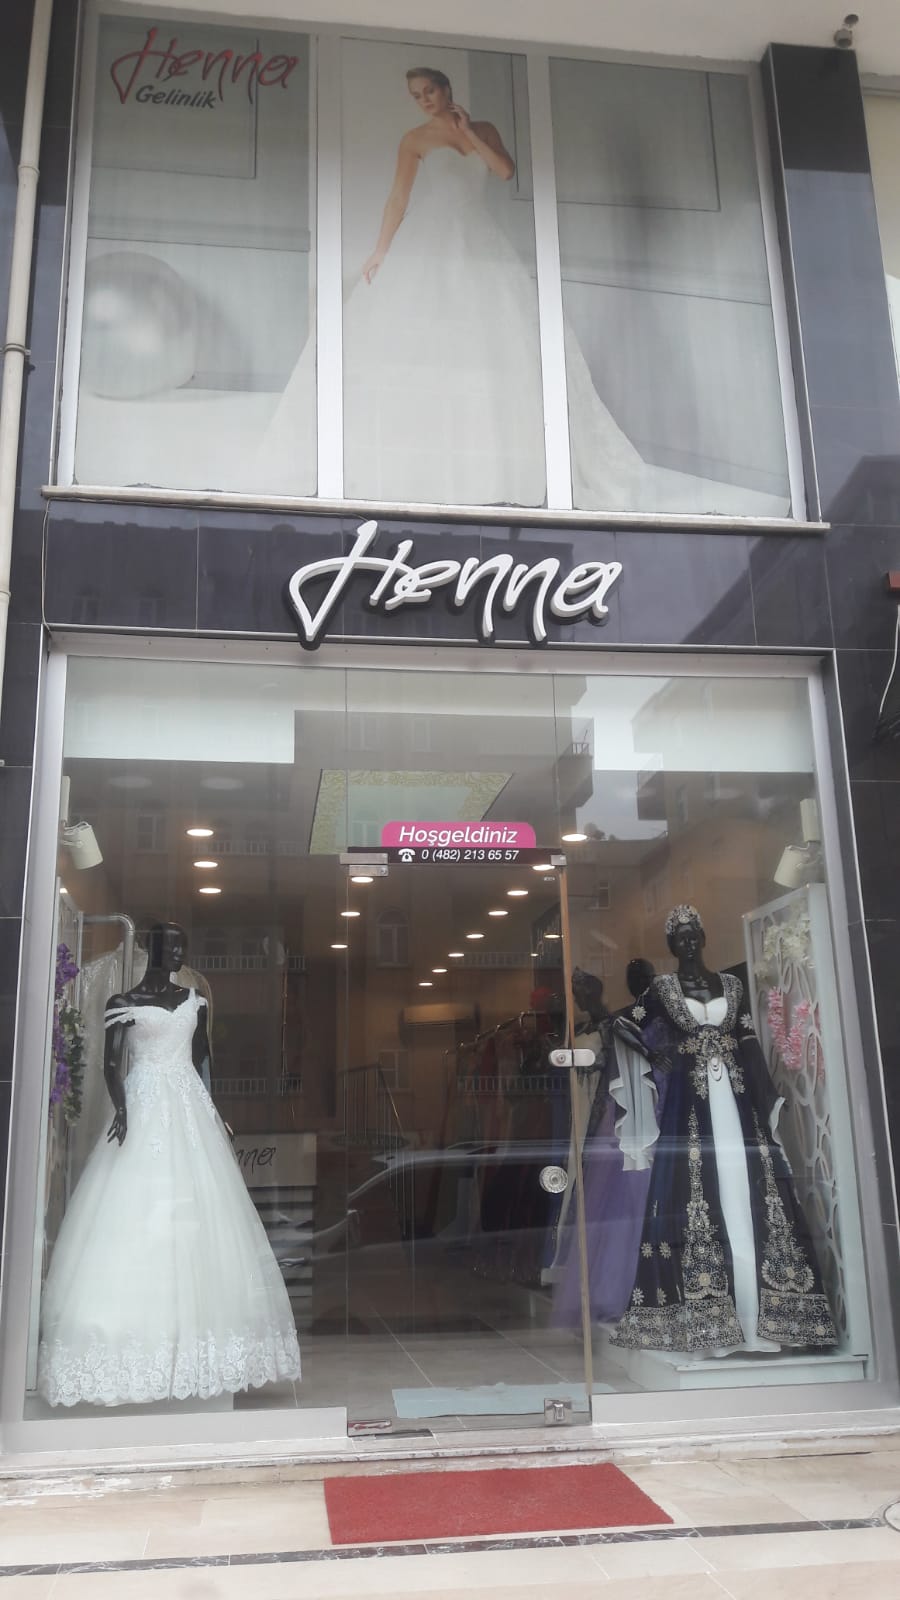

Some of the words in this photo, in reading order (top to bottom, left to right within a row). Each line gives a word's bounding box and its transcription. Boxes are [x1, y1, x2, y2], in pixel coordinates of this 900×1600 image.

[110, 26, 299, 104] Henna
[135, 84, 216, 109] Gelinlik
[288, 519, 623, 642] Henna
[398, 826, 518, 847] Hoşgeldiniz
[421, 850, 429, 860] 0
[432, 849, 461, 862] (482)
[463, 850, 485, 860] 213
[487, 850, 502, 860] 65
[504, 850, 519, 860] 57
